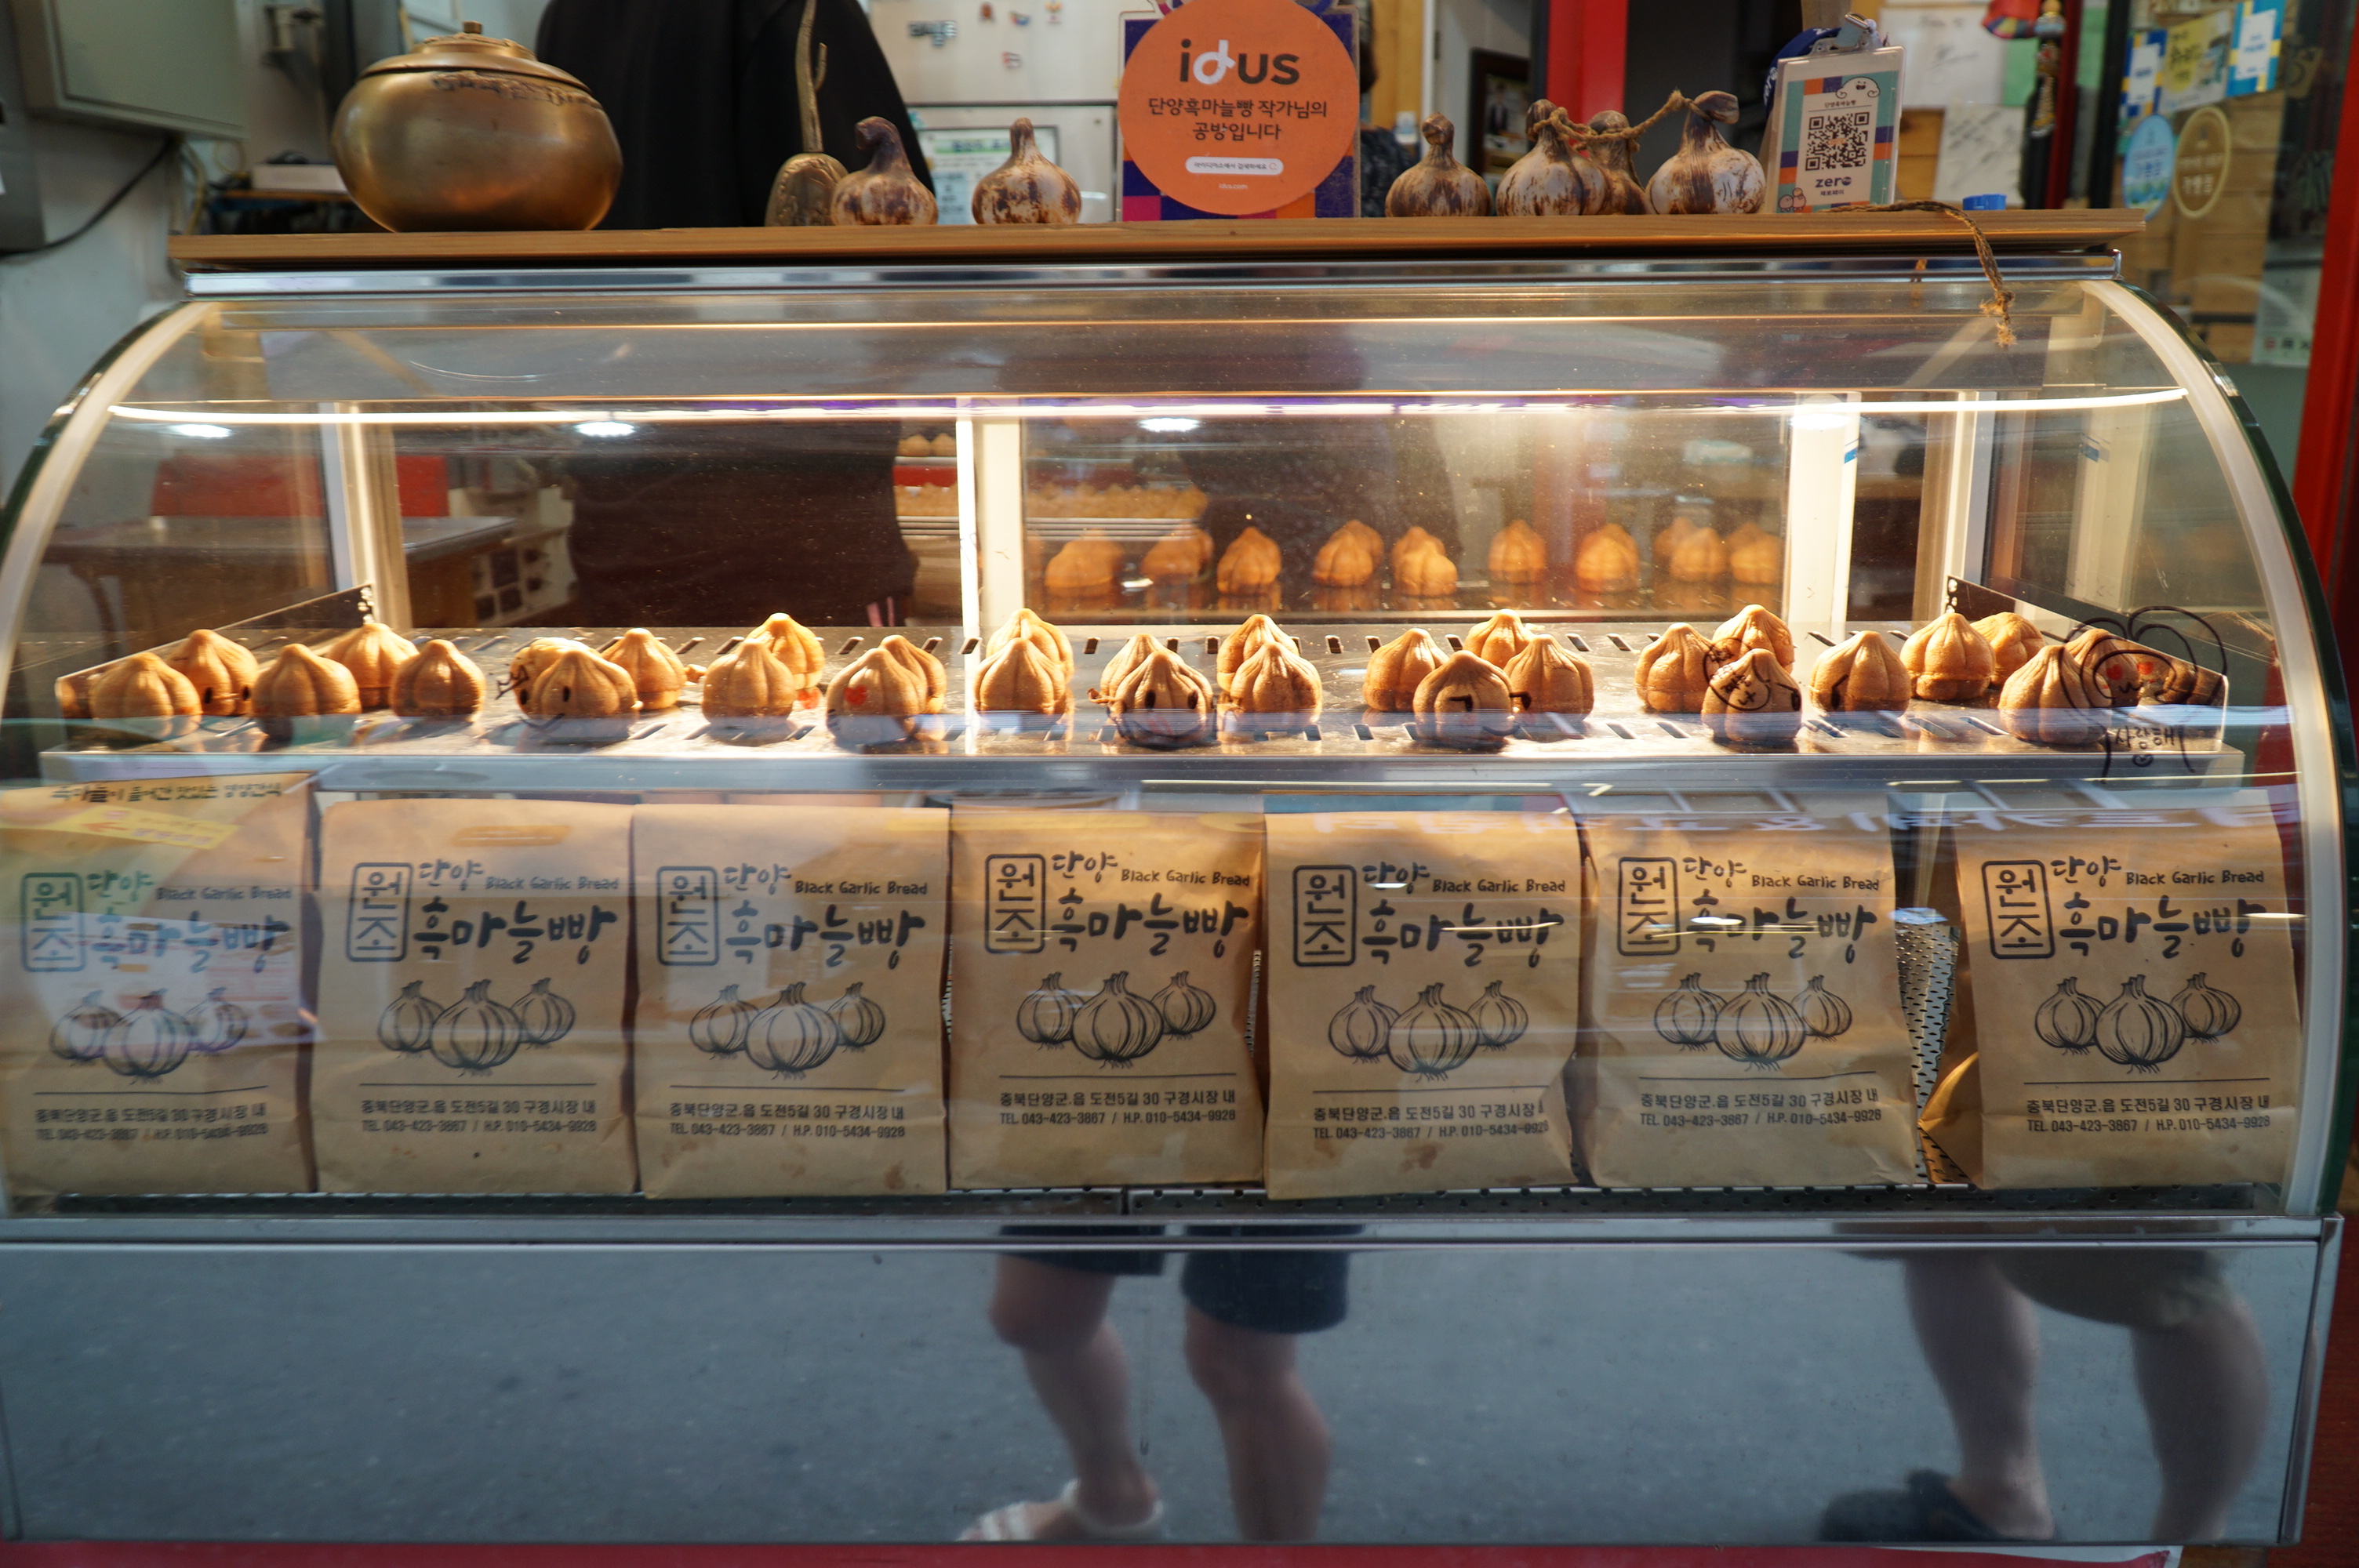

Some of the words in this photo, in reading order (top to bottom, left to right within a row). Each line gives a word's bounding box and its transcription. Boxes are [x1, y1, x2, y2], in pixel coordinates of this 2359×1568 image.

[1180, 38, 1300, 85] idus
[1148, 97, 1254, 118] 단양흑마늘빵
[1258, 100, 1327, 119] 작가님의
[1193, 122, 1281, 141] 공방입니다
[420, 858, 485, 891] 단양
[485, 876, 524, 890] Black
[529, 876, 572, 891] Garlic
[578, 876, 619, 890] Bread
[723, 863, 792, 895] 단양
[1051, 850, 1118, 884] 단양
[1121, 869, 1160, 884] Black
[1166, 869, 1206, 885] Garlic
[1212, 872, 1250, 887] Bread
[1362, 862, 1430, 895] 단양
[1682, 855, 1747, 889] 단양
[1752, 874, 1791, 887] Black
[1797, 875, 1837, 889] Garlic
[1842, 877, 1880, 891] Bread
[2050, 855, 2122, 887] 단양
[2126, 871, 2165, 885] Black
[2172, 871, 2215, 885] Garlic
[2221, 869, 2265, 884] Bread
[87, 869, 154, 902] 단양
[794, 880, 834, 895] Black
[839, 880, 880, 895] Garlic
[887, 880, 929, 895] Bread
[995, 862, 1035, 942] 원조
[1432, 879, 1471, 893] Black
[1477, 879, 1519, 893] Garlic
[1525, 879, 1565, 893] Bread
[32, 881, 75, 961] 원조
[356, 870, 403, 951] 원조
[667, 875, 709, 955] 원조
[1050, 887, 1249, 958] 흑마늘빵
[1303, 873, 1346, 955] 원조
[1627, 866, 1669, 946] 원조
[1996, 869, 2044, 948] 원조
[91, 906, 291, 974] 흑마늘빵
[413, 895, 618, 964] 흑마늘빵
[725, 899, 925, 970] 흑마늘빵
[1361, 898, 1564, 968] 흑마늘빵
[1685, 888, 1878, 964] 흑마늘빵
[2059, 891, 2267, 958] 흑마늘빵
[813, 1105, 831, 1118] 30
[834, 1105, 888, 1120] 구경시장
[891, 1106, 905, 1120] 내
[1090, 1091, 1139, 1106] 도전5길
[1143, 1092, 1159, 1105] 30
[1164, 1091, 1218, 1105] 구경시장
[1222, 1089, 1235, 1104] 내
[1459, 1105, 1475, 1119] 30
[1479, 1103, 1535, 1119] 구경시장
[1734, 1093, 1784, 1108] 도전5길
[1789, 1094, 1806, 1107] 30
[1810, 1089, 1863, 1107] 구경시장
[1866, 1087, 1879, 1103] 내
[2121, 1098, 2170, 1113] 도전5길
[2175, 1098, 2190, 1111] 30
[2194, 1095, 2253, 1112] 구경시장
[2259, 1094, 2270, 1109] 내
